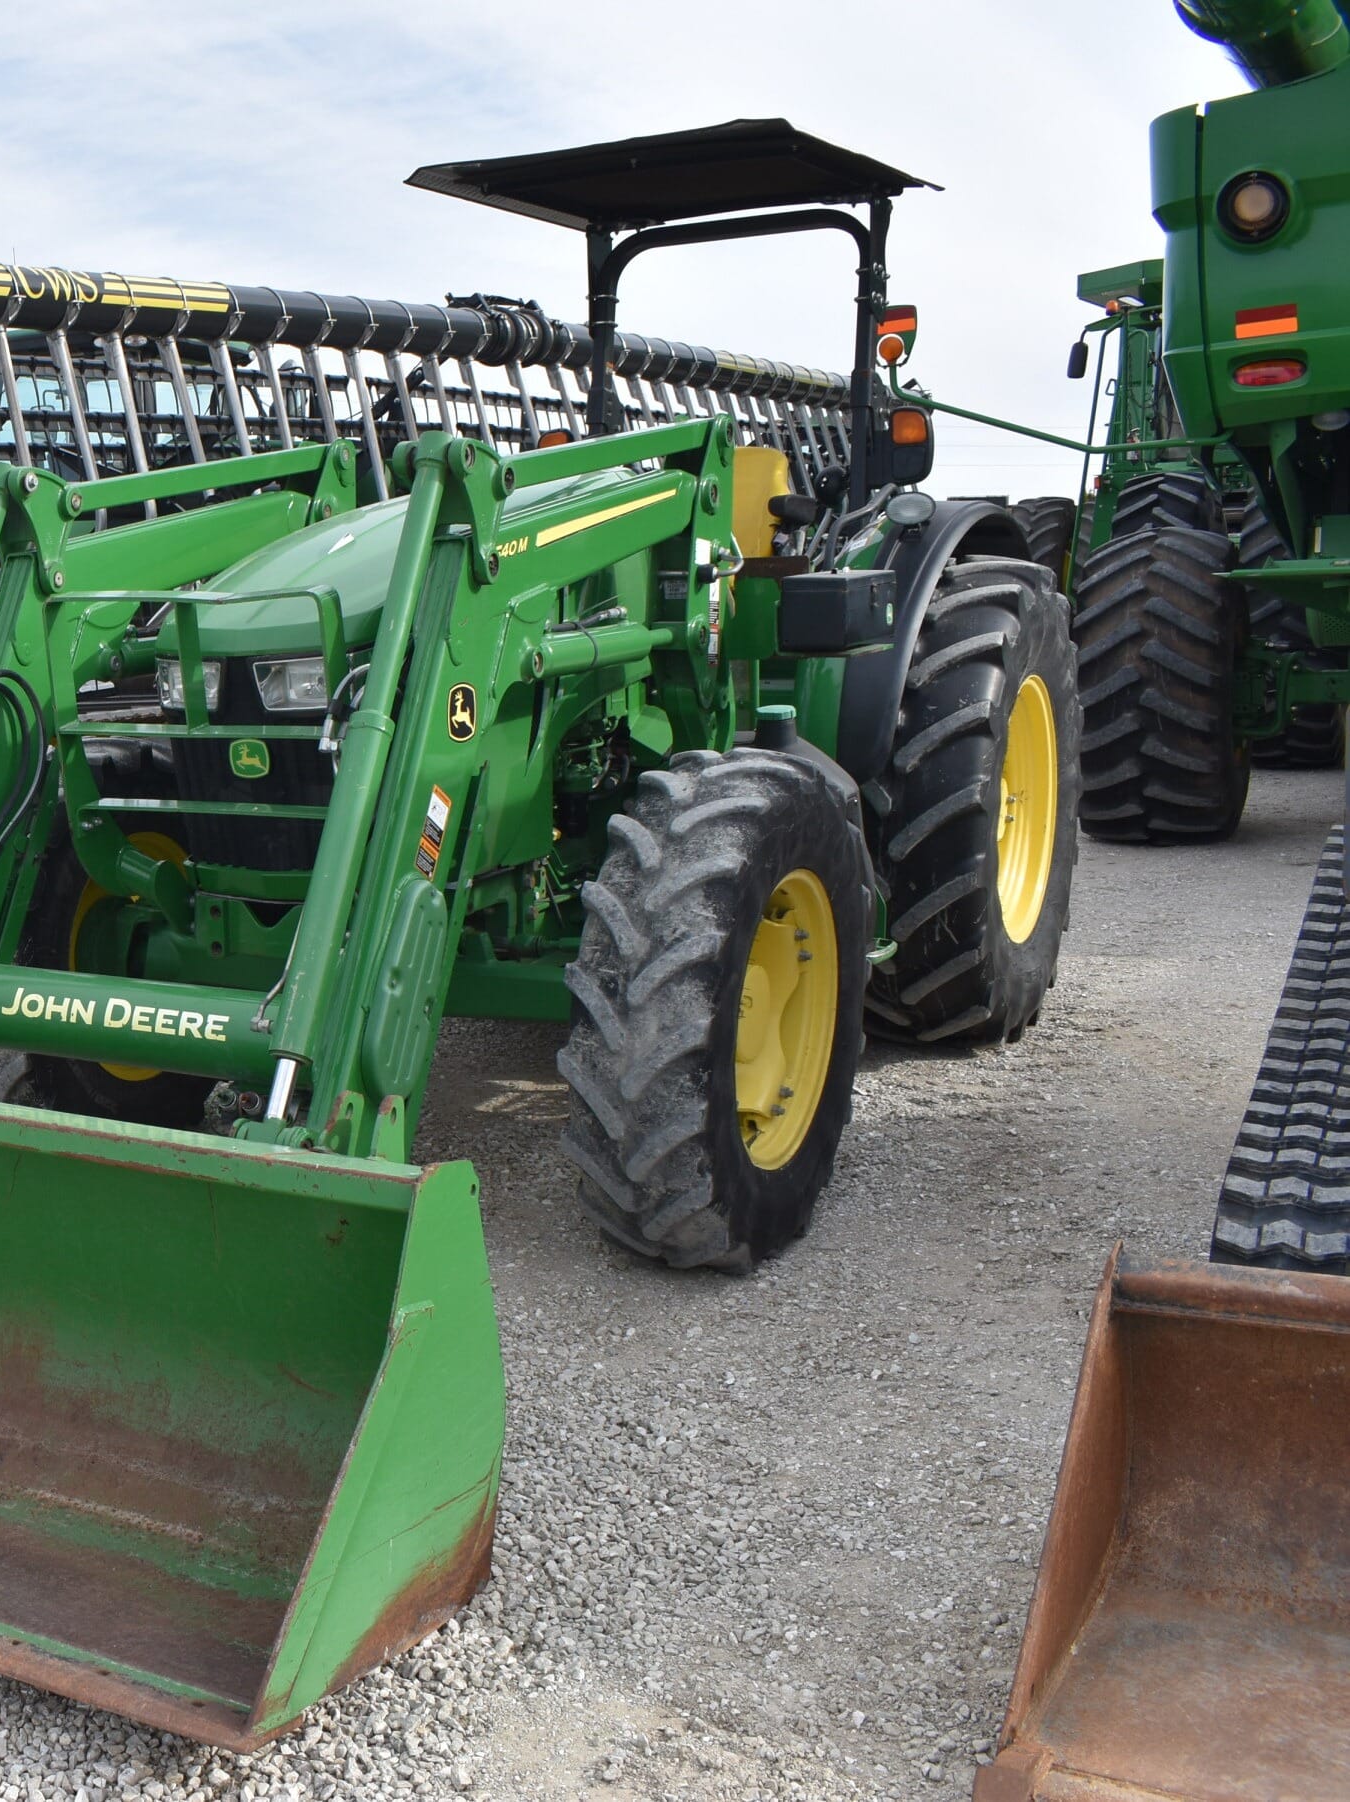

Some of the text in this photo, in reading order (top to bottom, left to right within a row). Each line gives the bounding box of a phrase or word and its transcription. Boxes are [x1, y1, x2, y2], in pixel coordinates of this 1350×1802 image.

[12, 265, 98, 303] CWS
[1, 987, 230, 1042] JOHN DEERE
